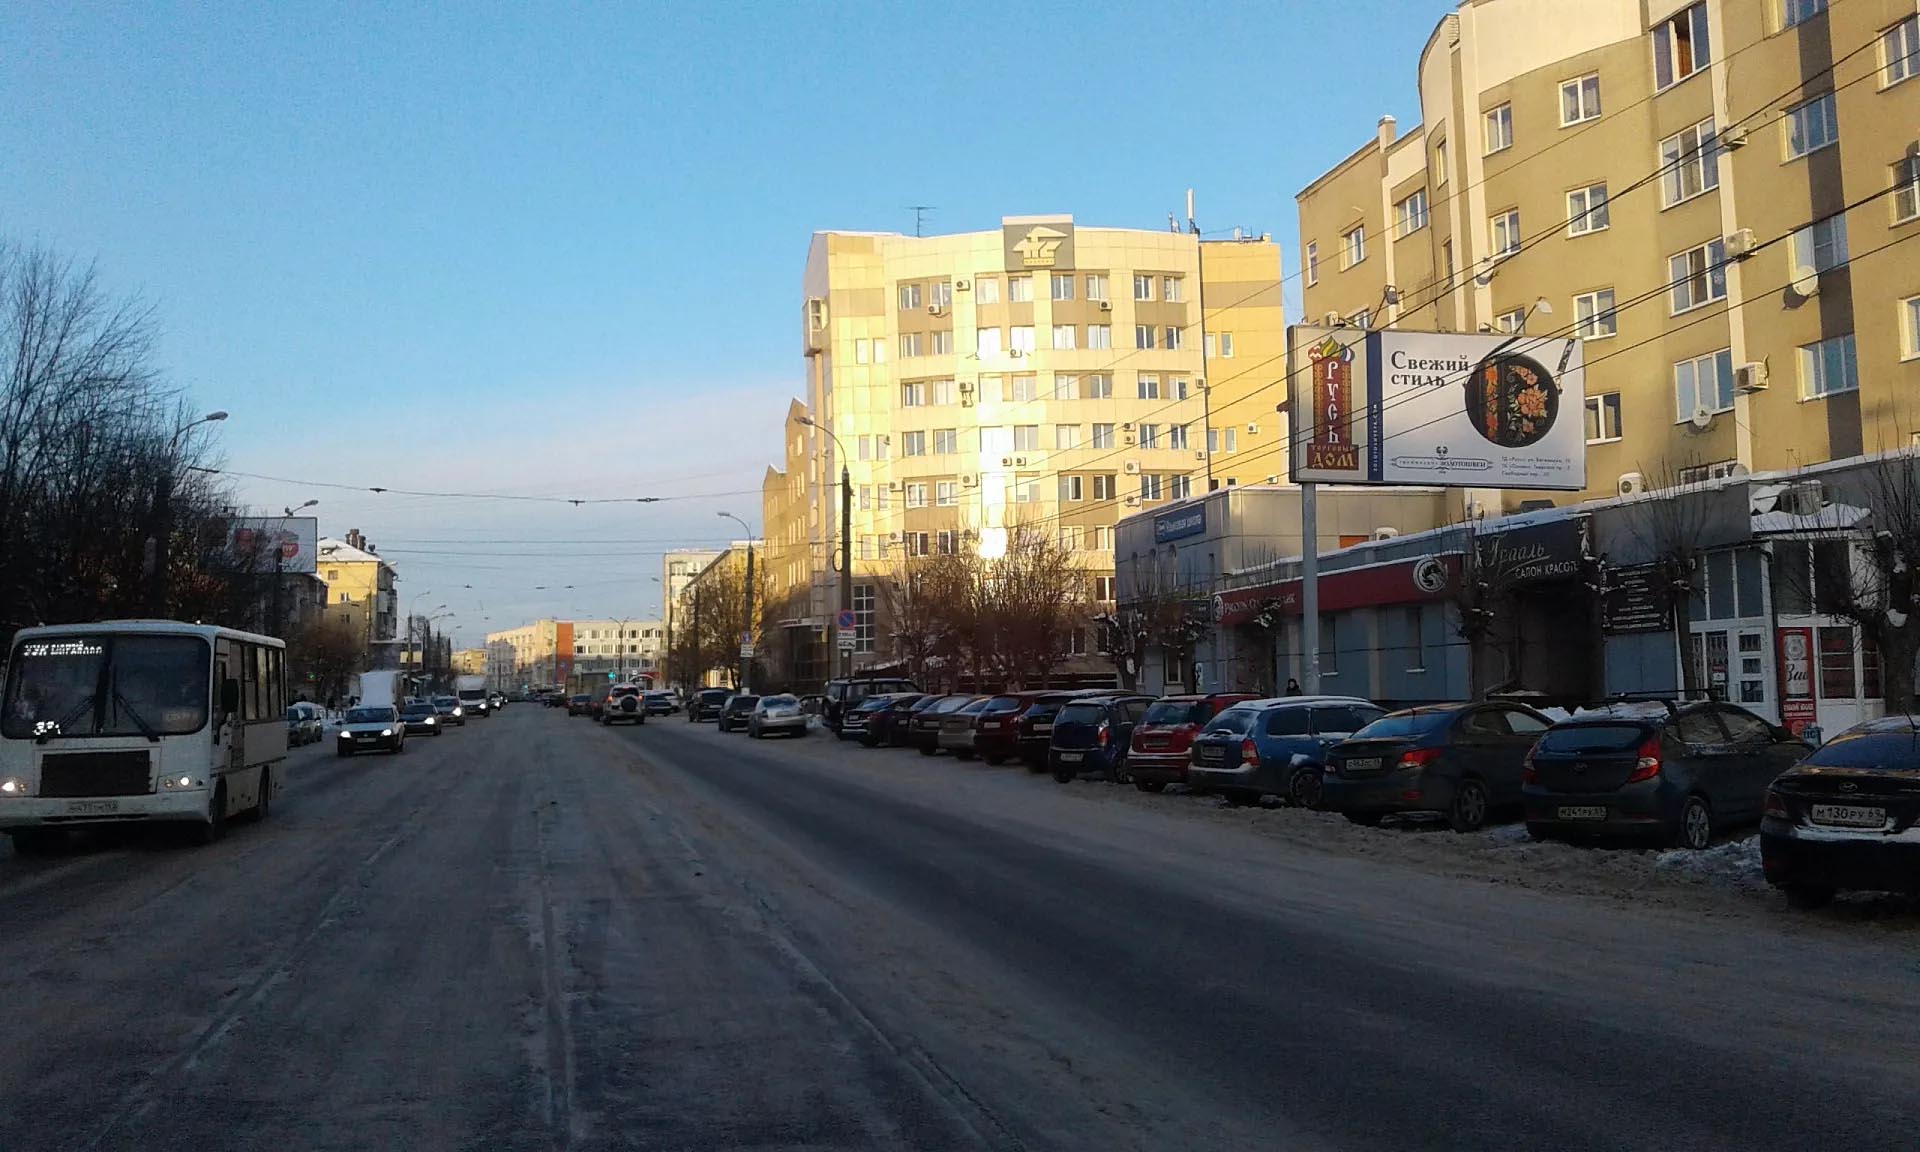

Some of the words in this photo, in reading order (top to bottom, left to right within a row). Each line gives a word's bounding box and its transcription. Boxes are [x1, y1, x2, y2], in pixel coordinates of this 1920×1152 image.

[1391, 350, 1469, 371] Свежий
[1391, 374, 1445, 387] стиль
[1312, 452, 1354, 469] ДОМ
[1515, 566, 1542, 579] САЛОН
